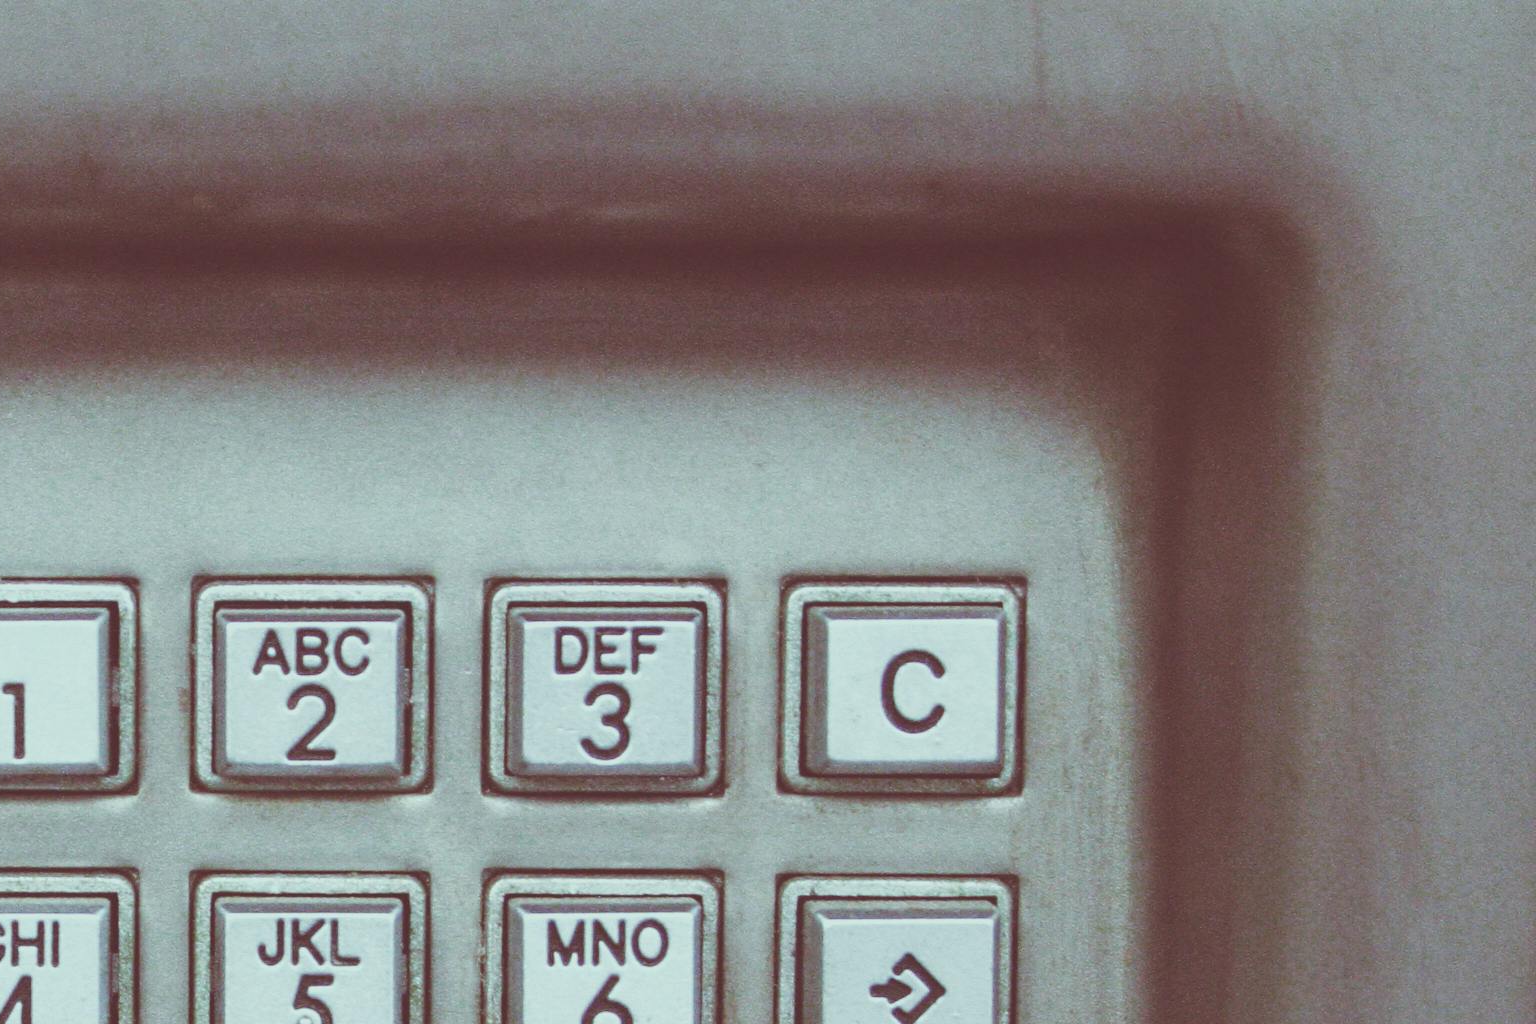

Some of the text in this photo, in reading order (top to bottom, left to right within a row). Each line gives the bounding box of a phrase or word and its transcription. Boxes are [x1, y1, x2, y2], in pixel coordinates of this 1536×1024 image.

[253, 628, 370, 676] ABC
[555, 627, 664, 674] DEF
[1, 683, 26, 760] 1
[881, 649, 945, 733] C
[286, 686, 336, 761] 2
[581, 684, 631, 760] 3
[258, 918, 360, 966] JKL
[547, 919, 669, 967] MNO
